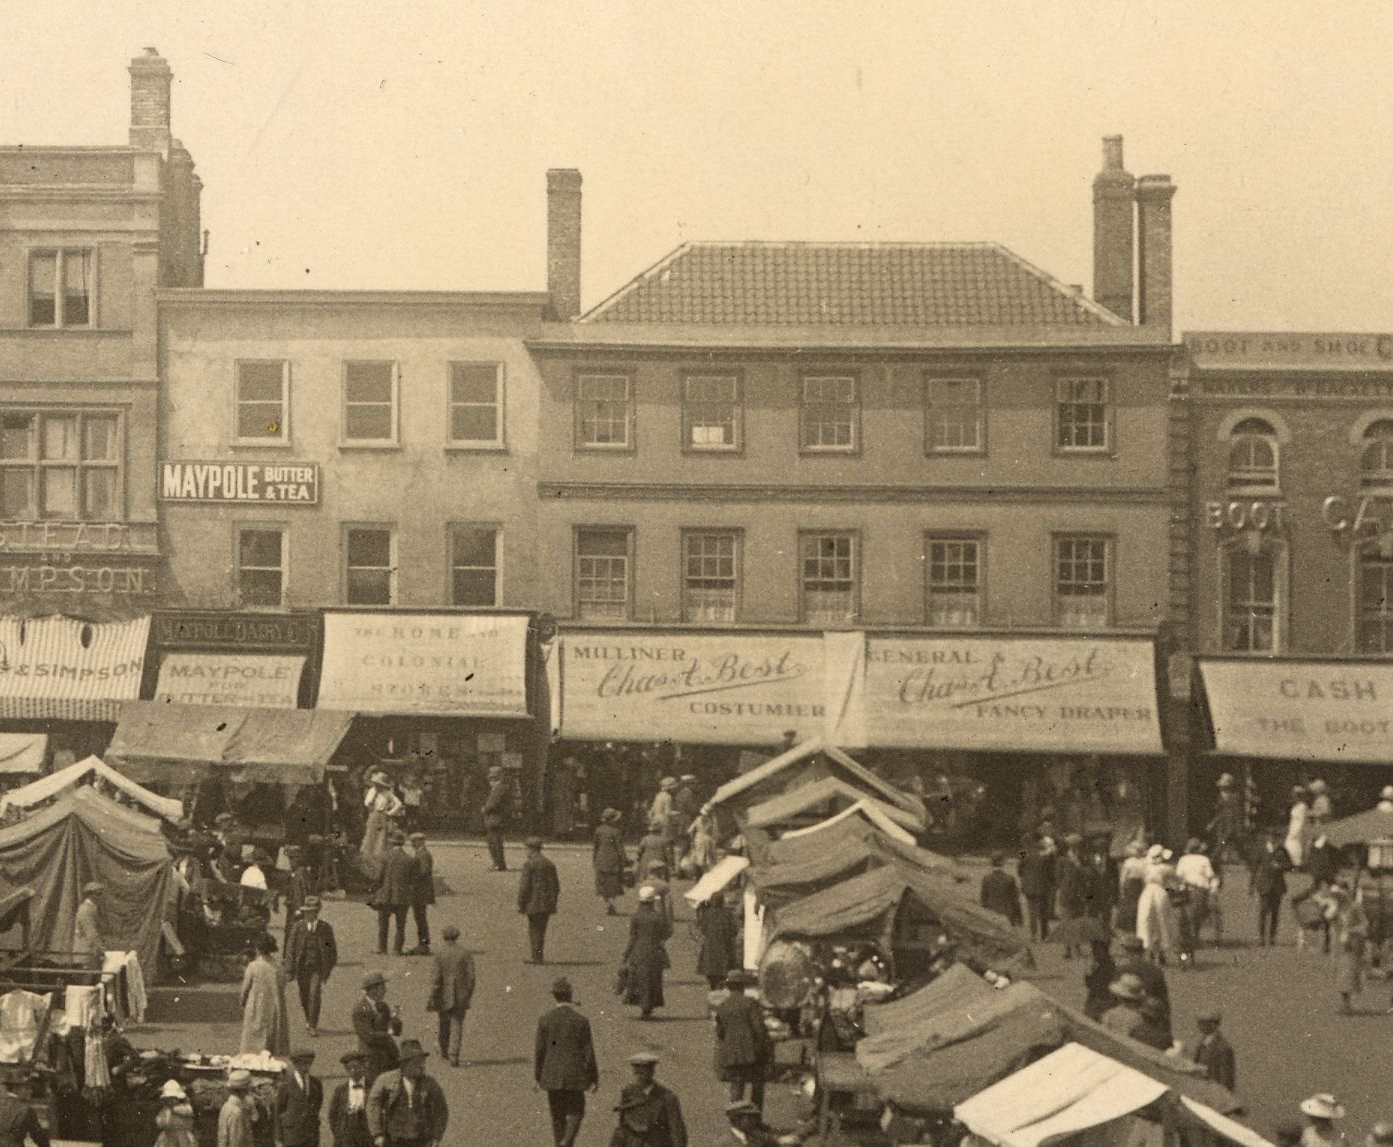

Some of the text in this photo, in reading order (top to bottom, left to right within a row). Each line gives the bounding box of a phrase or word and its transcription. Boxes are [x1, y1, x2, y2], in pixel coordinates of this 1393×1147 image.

[163, 464, 313, 499] MAYPOLE BUTTER
[265, 485, 310, 499] & TEA
[1207, 502, 1285, 528] BOOT
[41, 552, 72, 563] AND
[392, 627, 459, 640] HOME
[362, 655, 485, 669] COLONIAL
[573, 646, 687, 662] MILLINER
[169, 665, 291, 680] MAYPOLE
[1280, 679, 1377, 700] CASH
[689, 702, 826, 718] COSTUMIER
[976, 704, 1153, 721] FANCY DRAPER
[1258, 717, 1392, 734] THE BOOT
